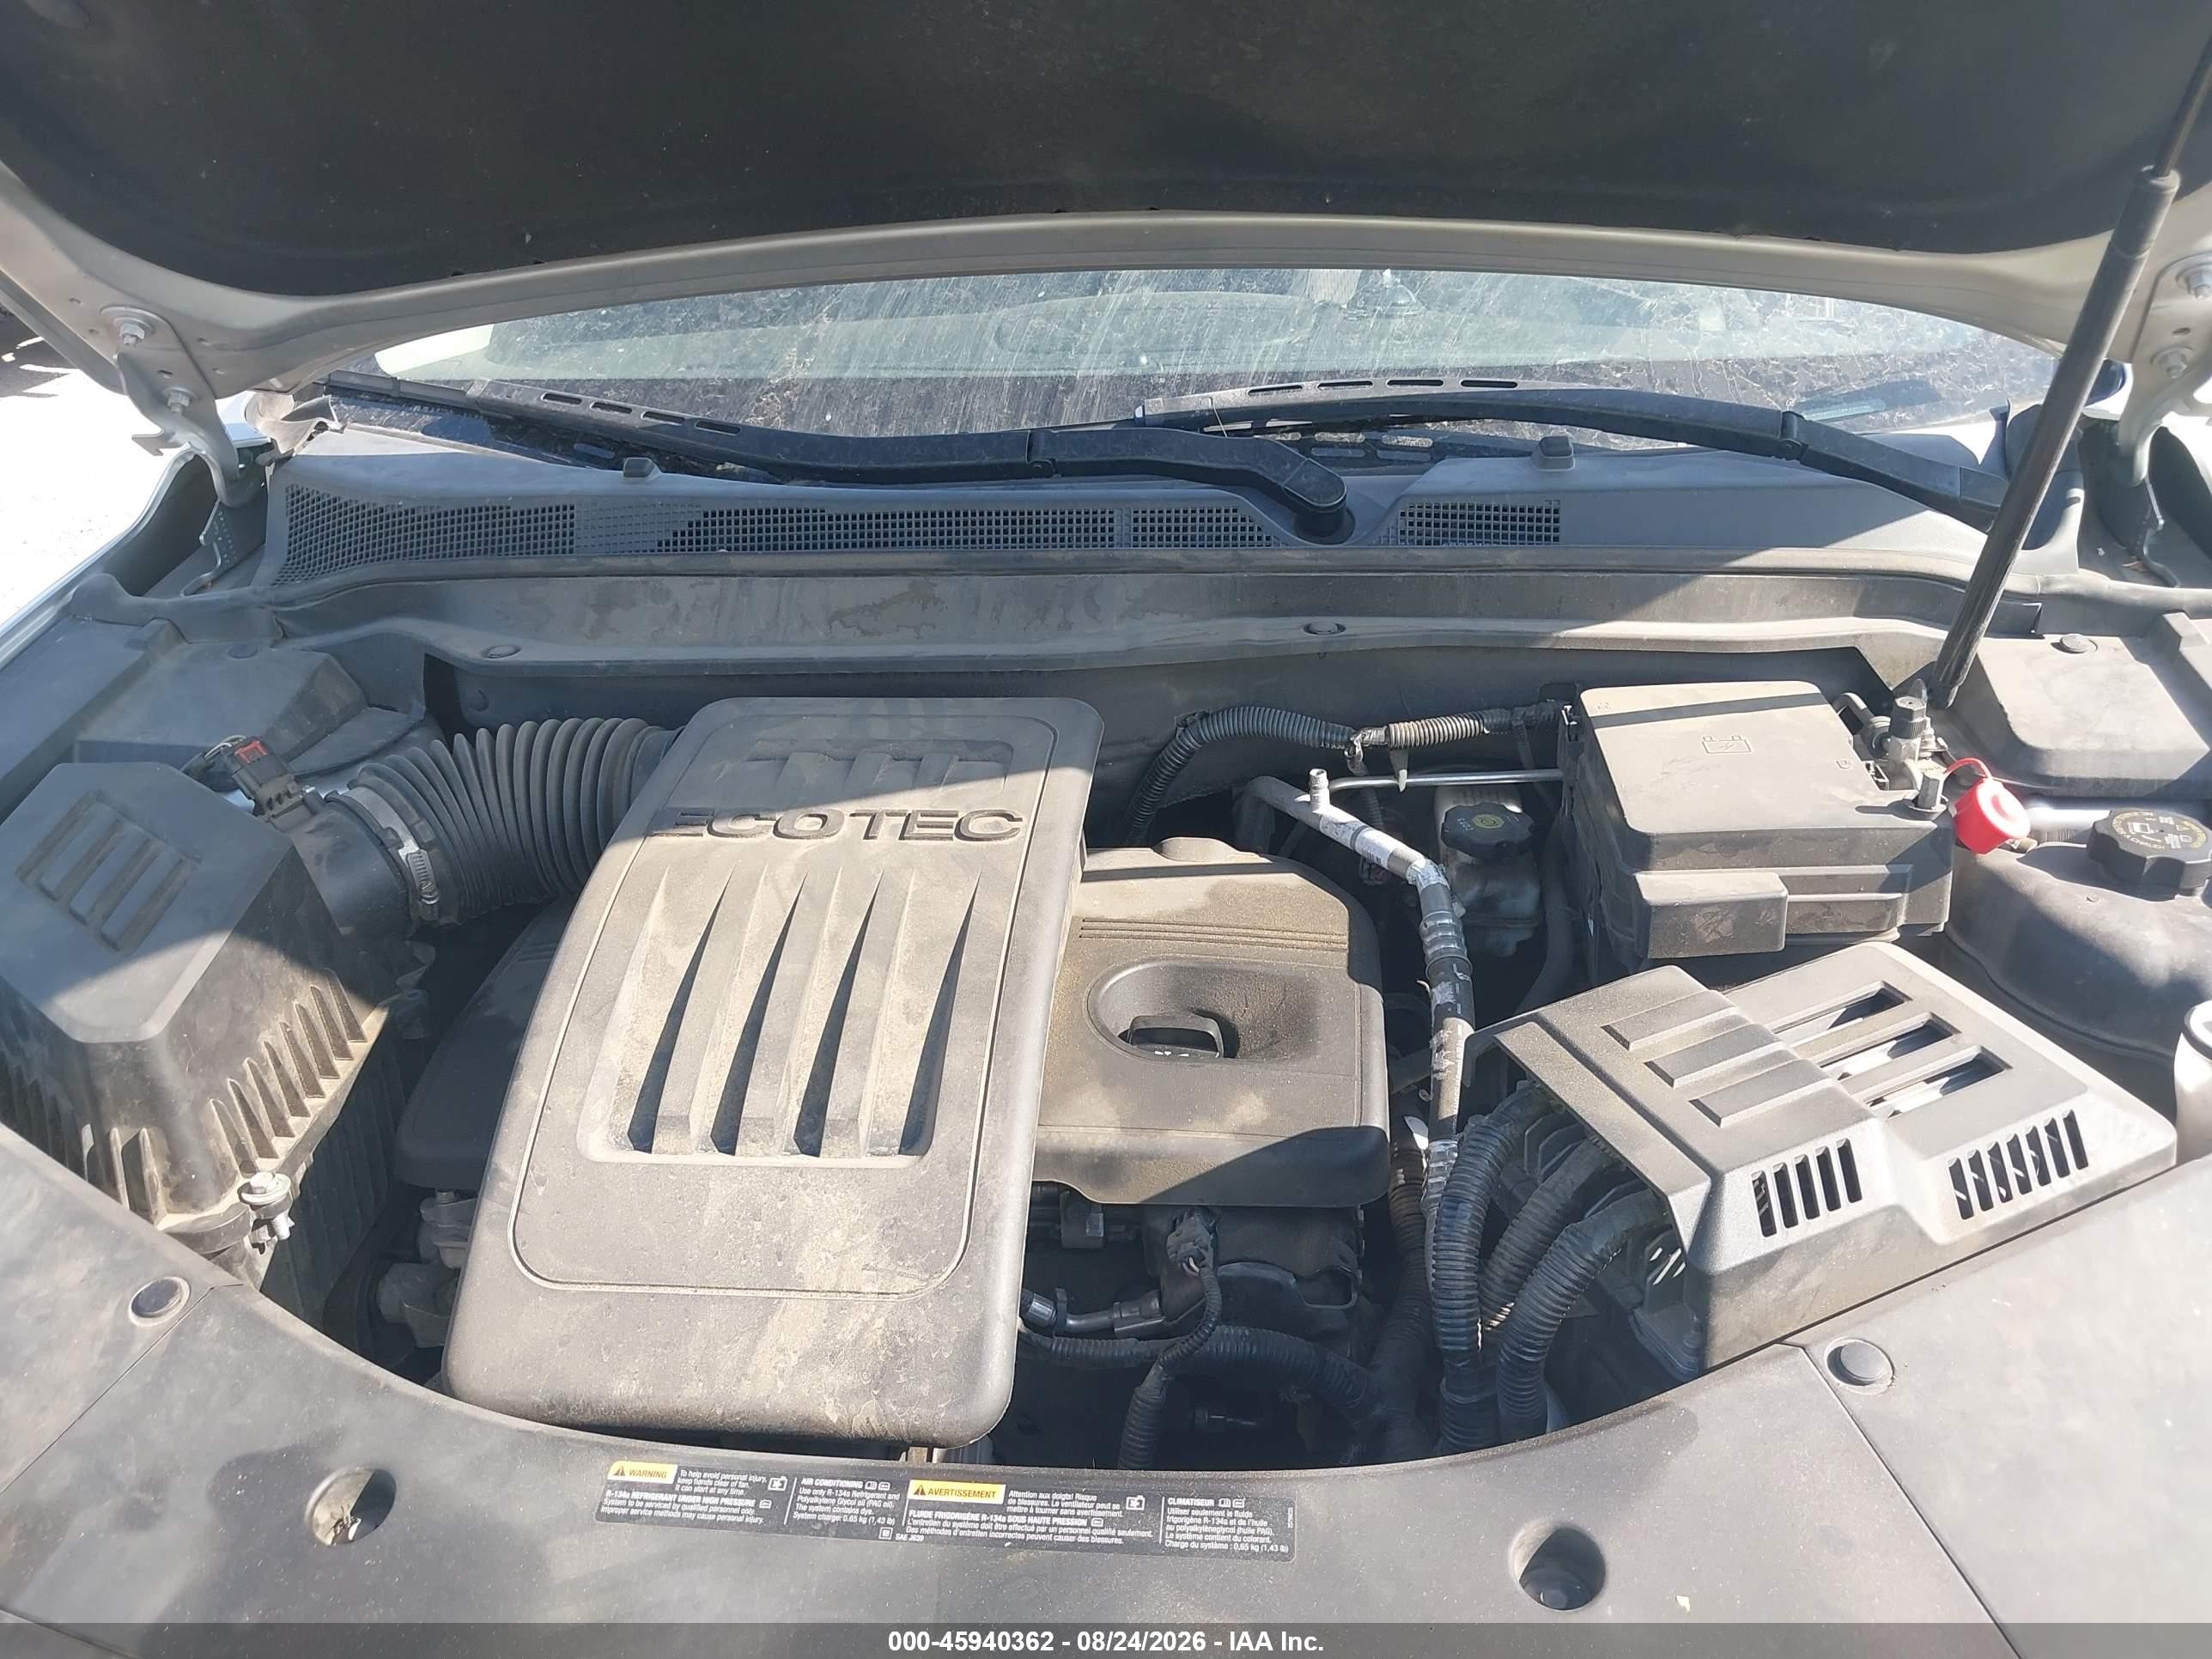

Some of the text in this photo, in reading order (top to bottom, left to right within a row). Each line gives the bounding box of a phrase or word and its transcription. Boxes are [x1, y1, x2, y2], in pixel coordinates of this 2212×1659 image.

[647, 809, 1024, 842] ECOTEC
[629, 1469, 666, 1479] WARNING
[721, 1473, 748, 1481] personal
[814, 1479, 863, 1489] CONDITIONING
[812, 1488, 826, 1497] only
[851, 1491, 886, 1499] Refrigerant
[927, 1488, 996, 1498] AVERTISSEMENT
[1009, 1490, 1037, 1499] Attention
[630, 1491, 678, 1501] REFRIGERANT
[678, 1494, 702, 1503] UNDER
[702, 1496, 720, 1504] HIGH
[720, 1497, 756, 1507] PRESSURE
[797, 1495, 836, 1505] Polyalkylene
[837, 1498, 856, 1506] Glycol
[866, 1499, 882, 1508] (PAG
[1168, 1498, 1215, 1506] CLIMATISEUR
[681, 1504, 708, 1512] qualified
[796, 1503, 808, 1511] The
[808, 1504, 831, 1514] system
[832, 1506, 860, 1515] contains
[1168, 1507, 1189, 1516] Utiliser
[1191, 1509, 1225, 1517] seulement
[1234, 1510, 1253, 1518] fluide
[601, 1505, 629, 1515] Improper
[653, 1509, 681, 1517] methods
[682, 1511, 696, 1520] may
[716, 1514, 744, 1523] personal
[793, 1511, 817, 1521] System
[859, 1516, 866, 1524] kg
[909, 1510, 934, 1518] FLUIDE
[981, 1514, 1006, 1522] R-134a
[1007, 1515, 1026, 1523] SOUS
[1028, 1516, 1051, 1524] HAUTE
[1052, 1516, 1087, 1527] PRESSION
[908, 1517, 941, 1527] L'entretien
[980, 1522, 993, 1530] doit
[1203, 1516, 1228, 1525] R-134a
[1247, 1518, 1267, 1527] l'huile
[953, 1528, 988, 1538] d'entretien
[989, 1531, 1025, 1540] incorrectes
[1165, 1540, 1189, 1549] Charge
[1250, 1543, 1260, 1553] kg
[1279, 1544, 1289, 1553] lb)
